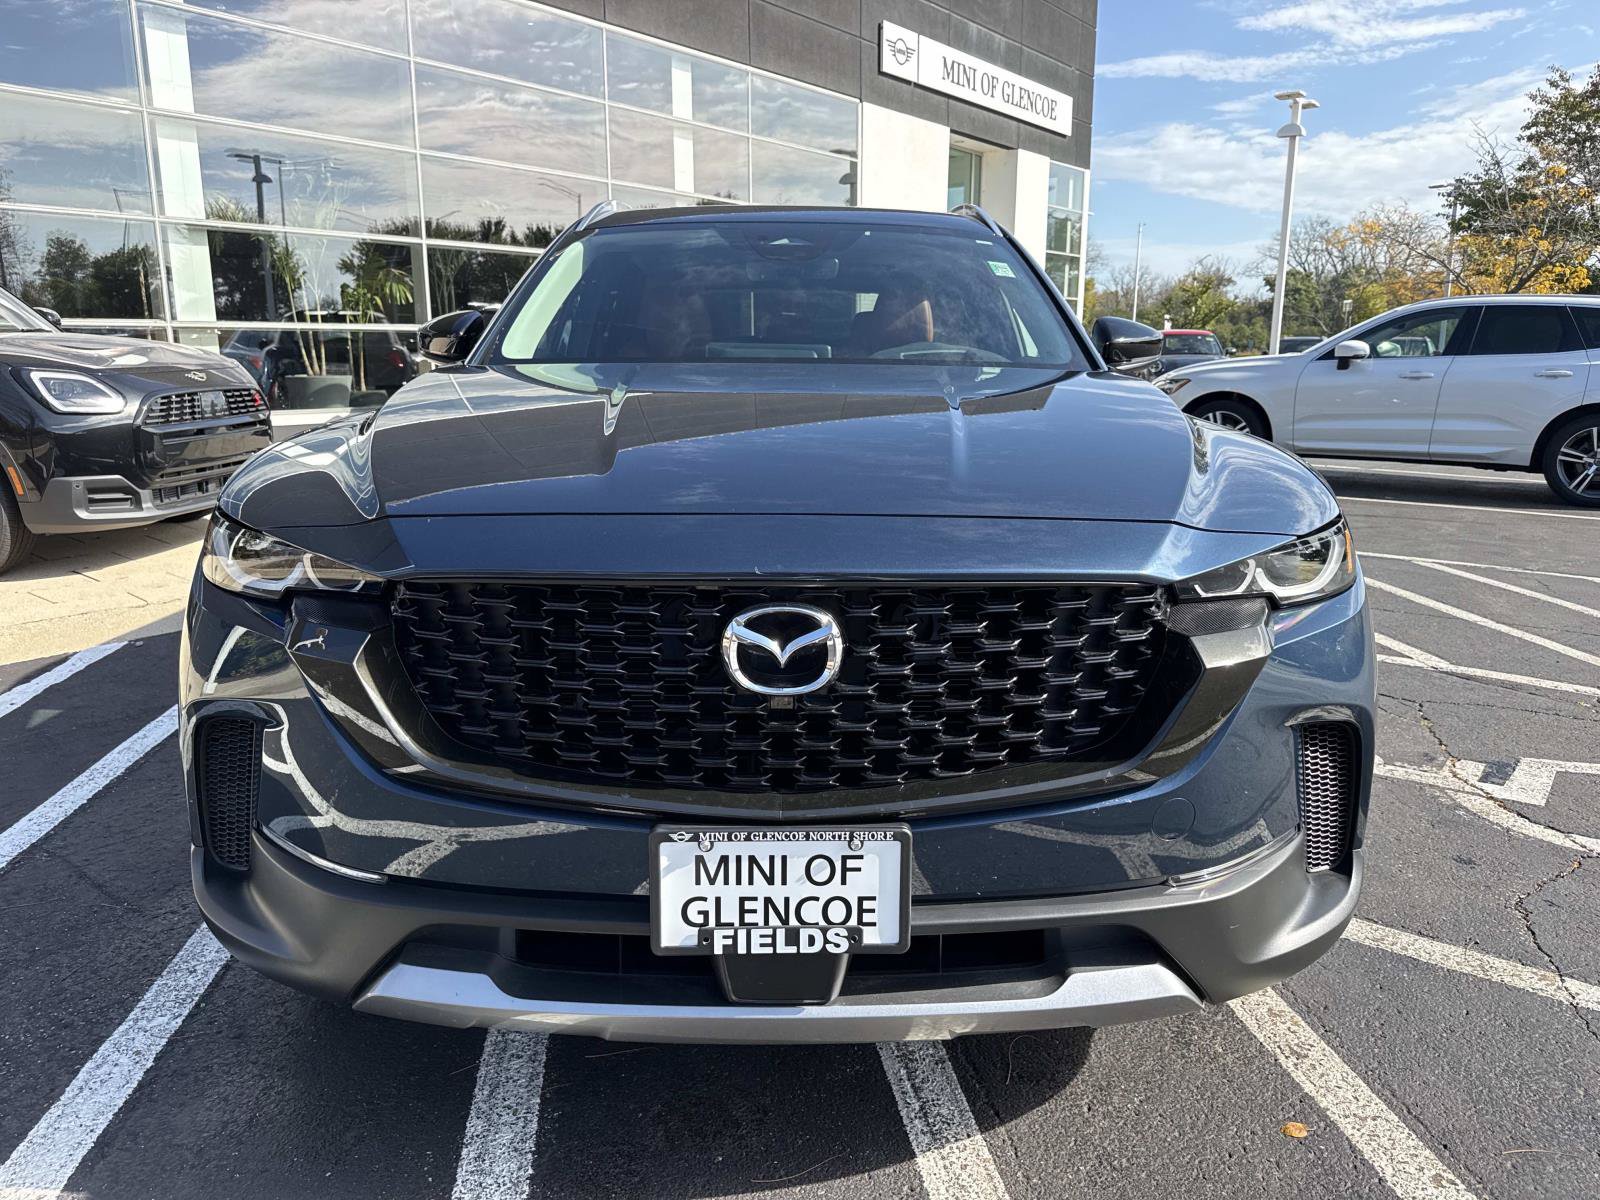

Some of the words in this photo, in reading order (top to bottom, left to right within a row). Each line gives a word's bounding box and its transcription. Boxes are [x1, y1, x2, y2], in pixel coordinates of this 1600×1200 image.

[942, 56, 977, 92] MINI
[981, 72, 998, 99] OF
[1001, 81, 1057, 121] GLENCOE
[699, 832, 728, 842] MINI
[732, 832, 748, 842] OF
[751, 832, 806, 842] GLENCOE
[809, 832, 850, 842] NORTH
[853, 832, 894, 842] SHORE
[694, 855, 788, 886] MINI
[804, 854, 864, 887] OF
[681, 896, 877, 927] GLENCOE
[713, 928, 850, 955] FIELDS
